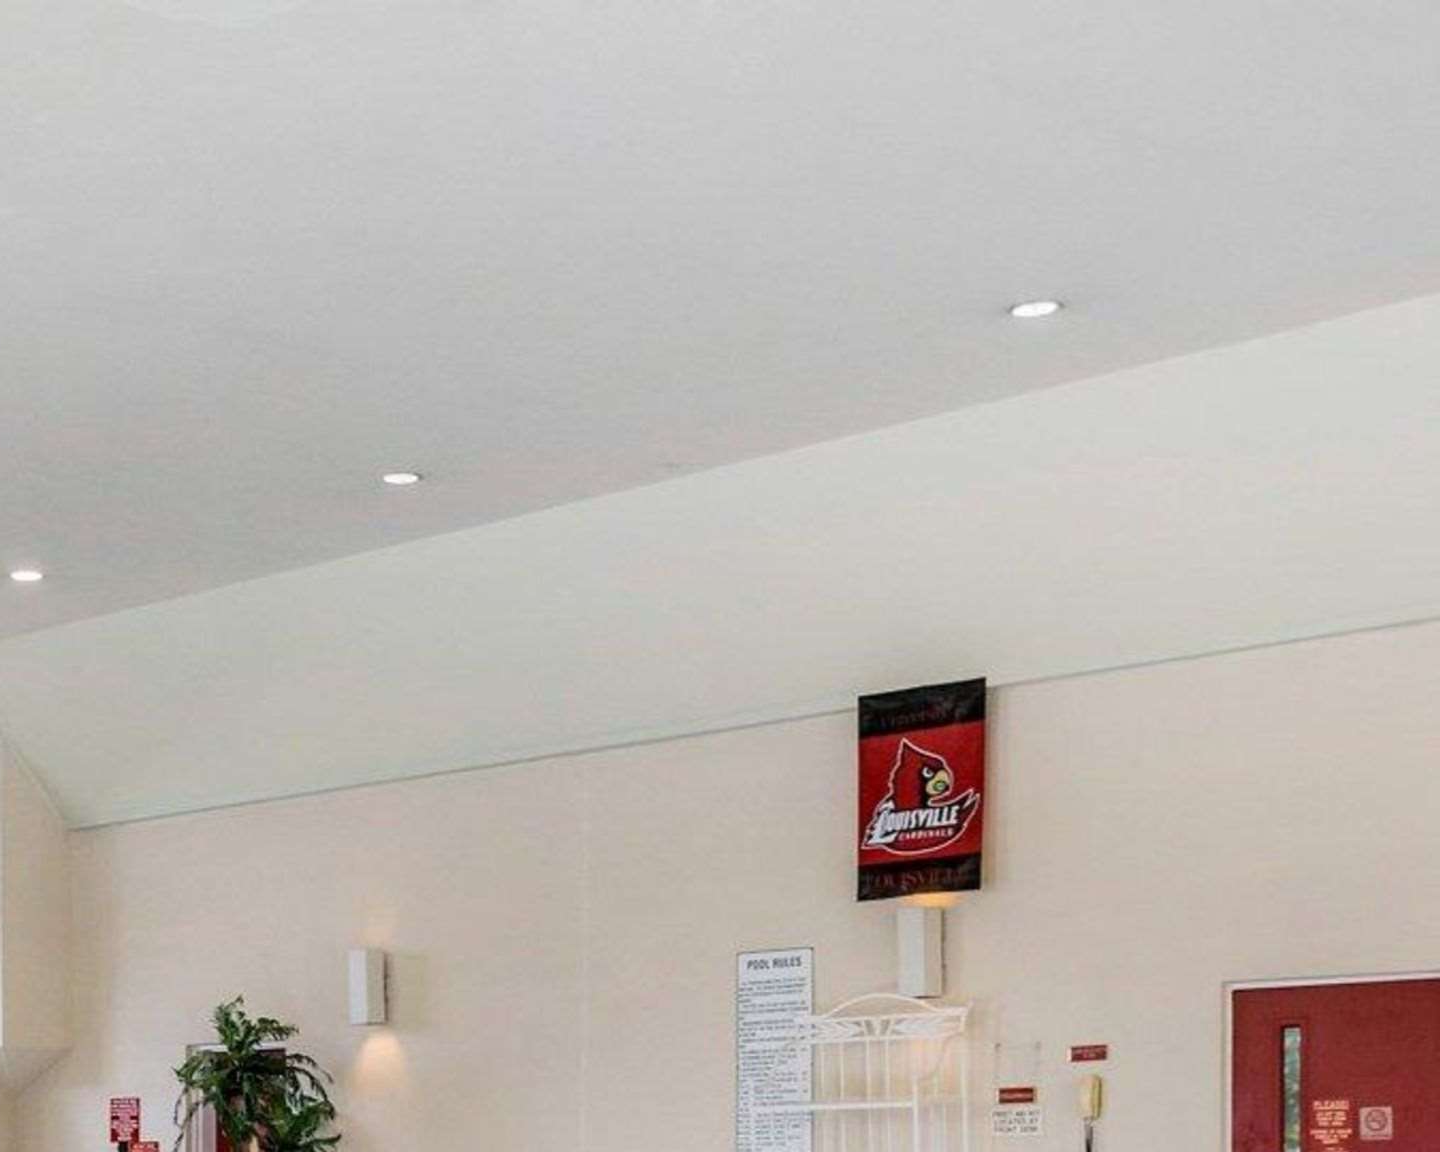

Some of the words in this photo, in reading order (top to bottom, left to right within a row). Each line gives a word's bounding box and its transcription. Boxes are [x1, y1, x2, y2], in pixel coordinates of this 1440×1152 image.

[867, 800, 960, 845] LOUISVILLE
[747, 959, 771, 970] POOL
[772, 956, 802, 968] RULES
